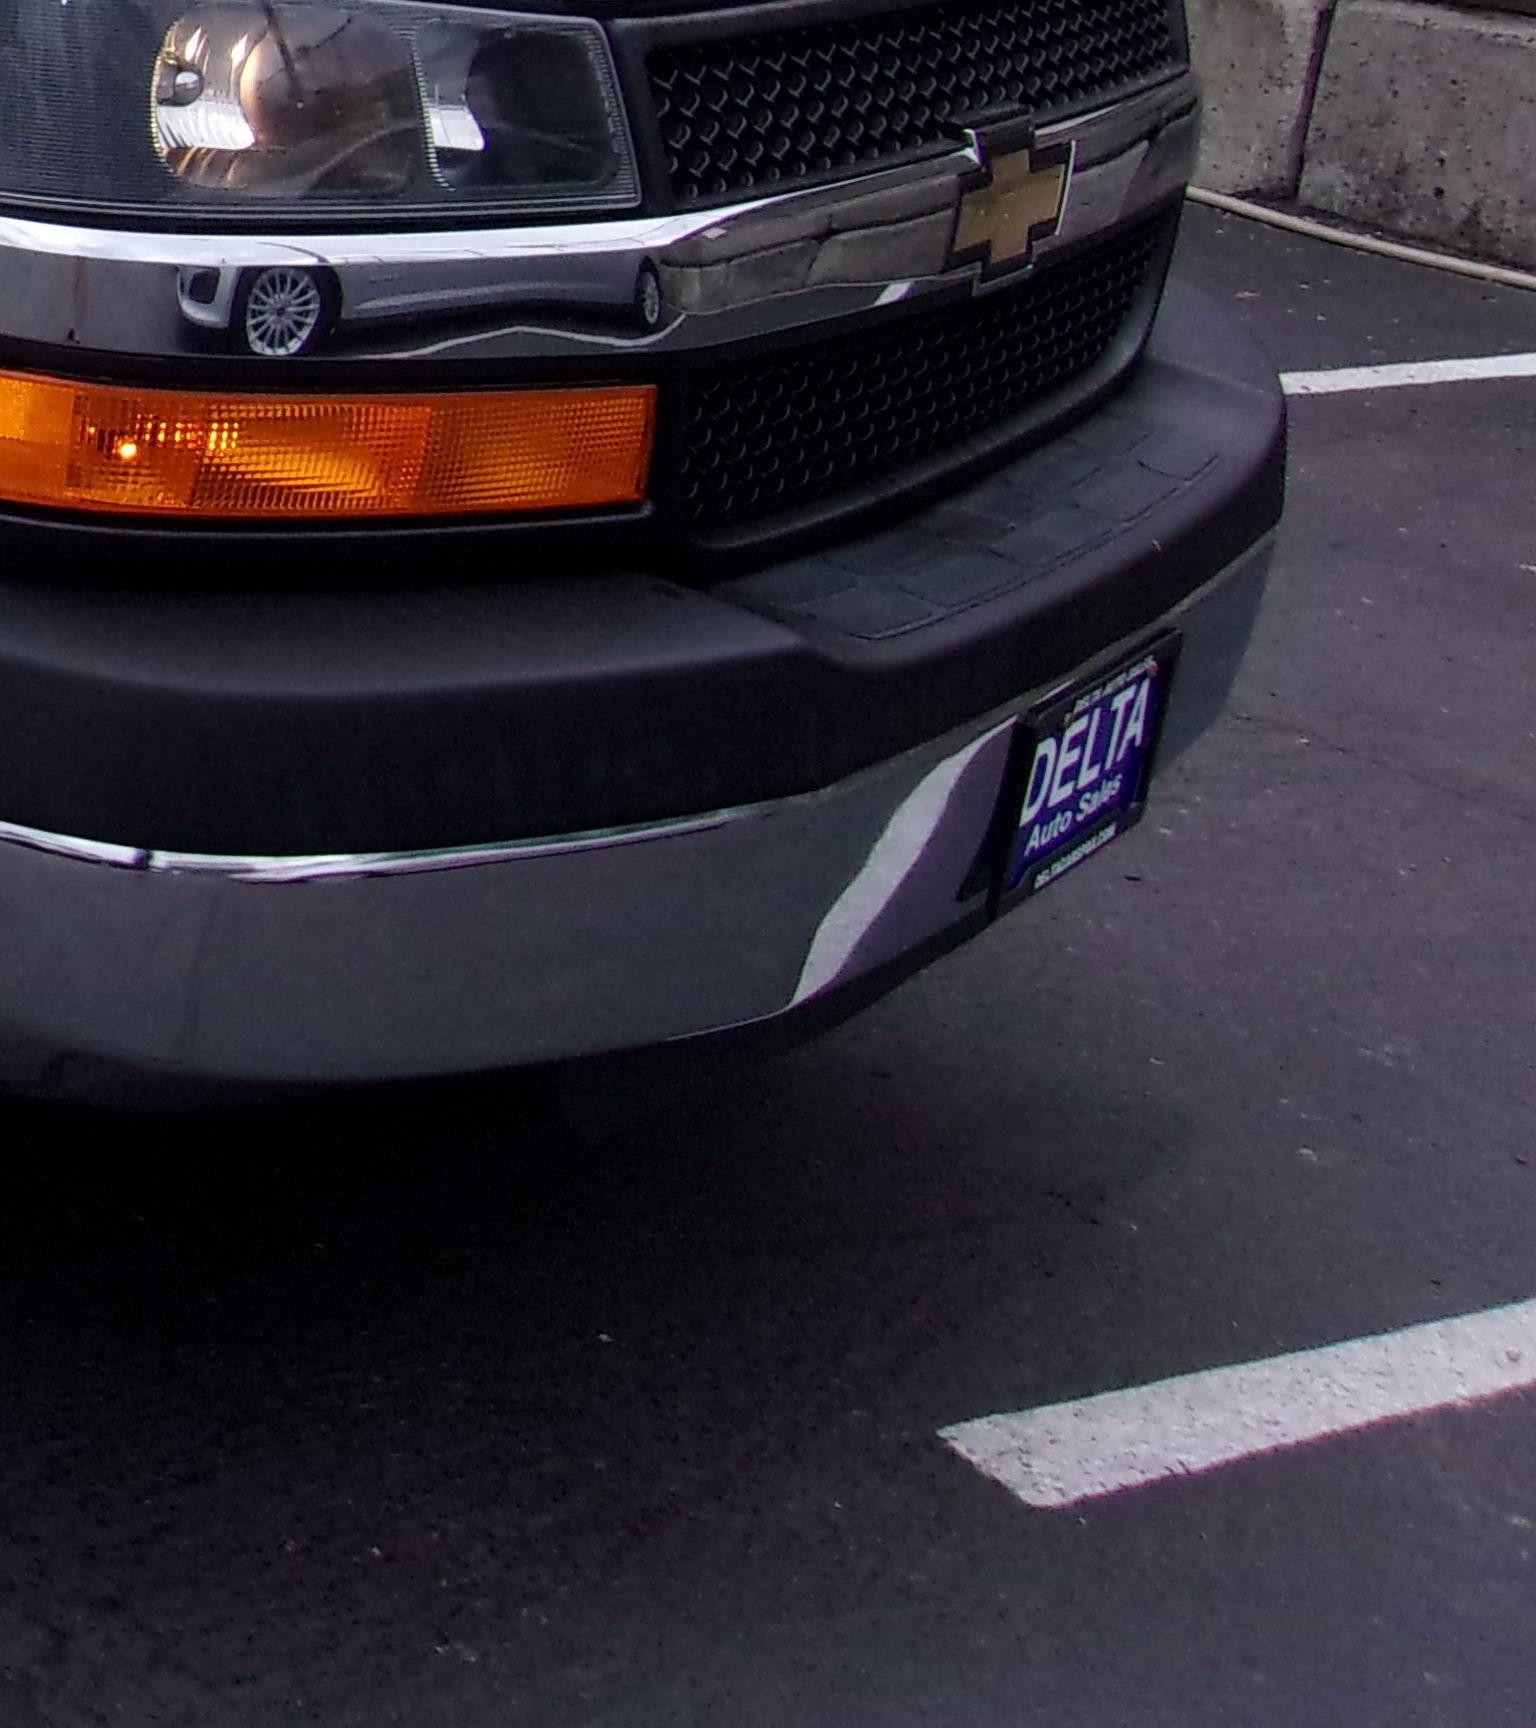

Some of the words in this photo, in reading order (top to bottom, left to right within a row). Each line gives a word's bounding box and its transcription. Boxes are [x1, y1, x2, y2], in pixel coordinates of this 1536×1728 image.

[1020, 677, 1151, 827] DELTA
[1024, 809, 1073, 857] Auto
[1075, 773, 1123, 823] Sales
